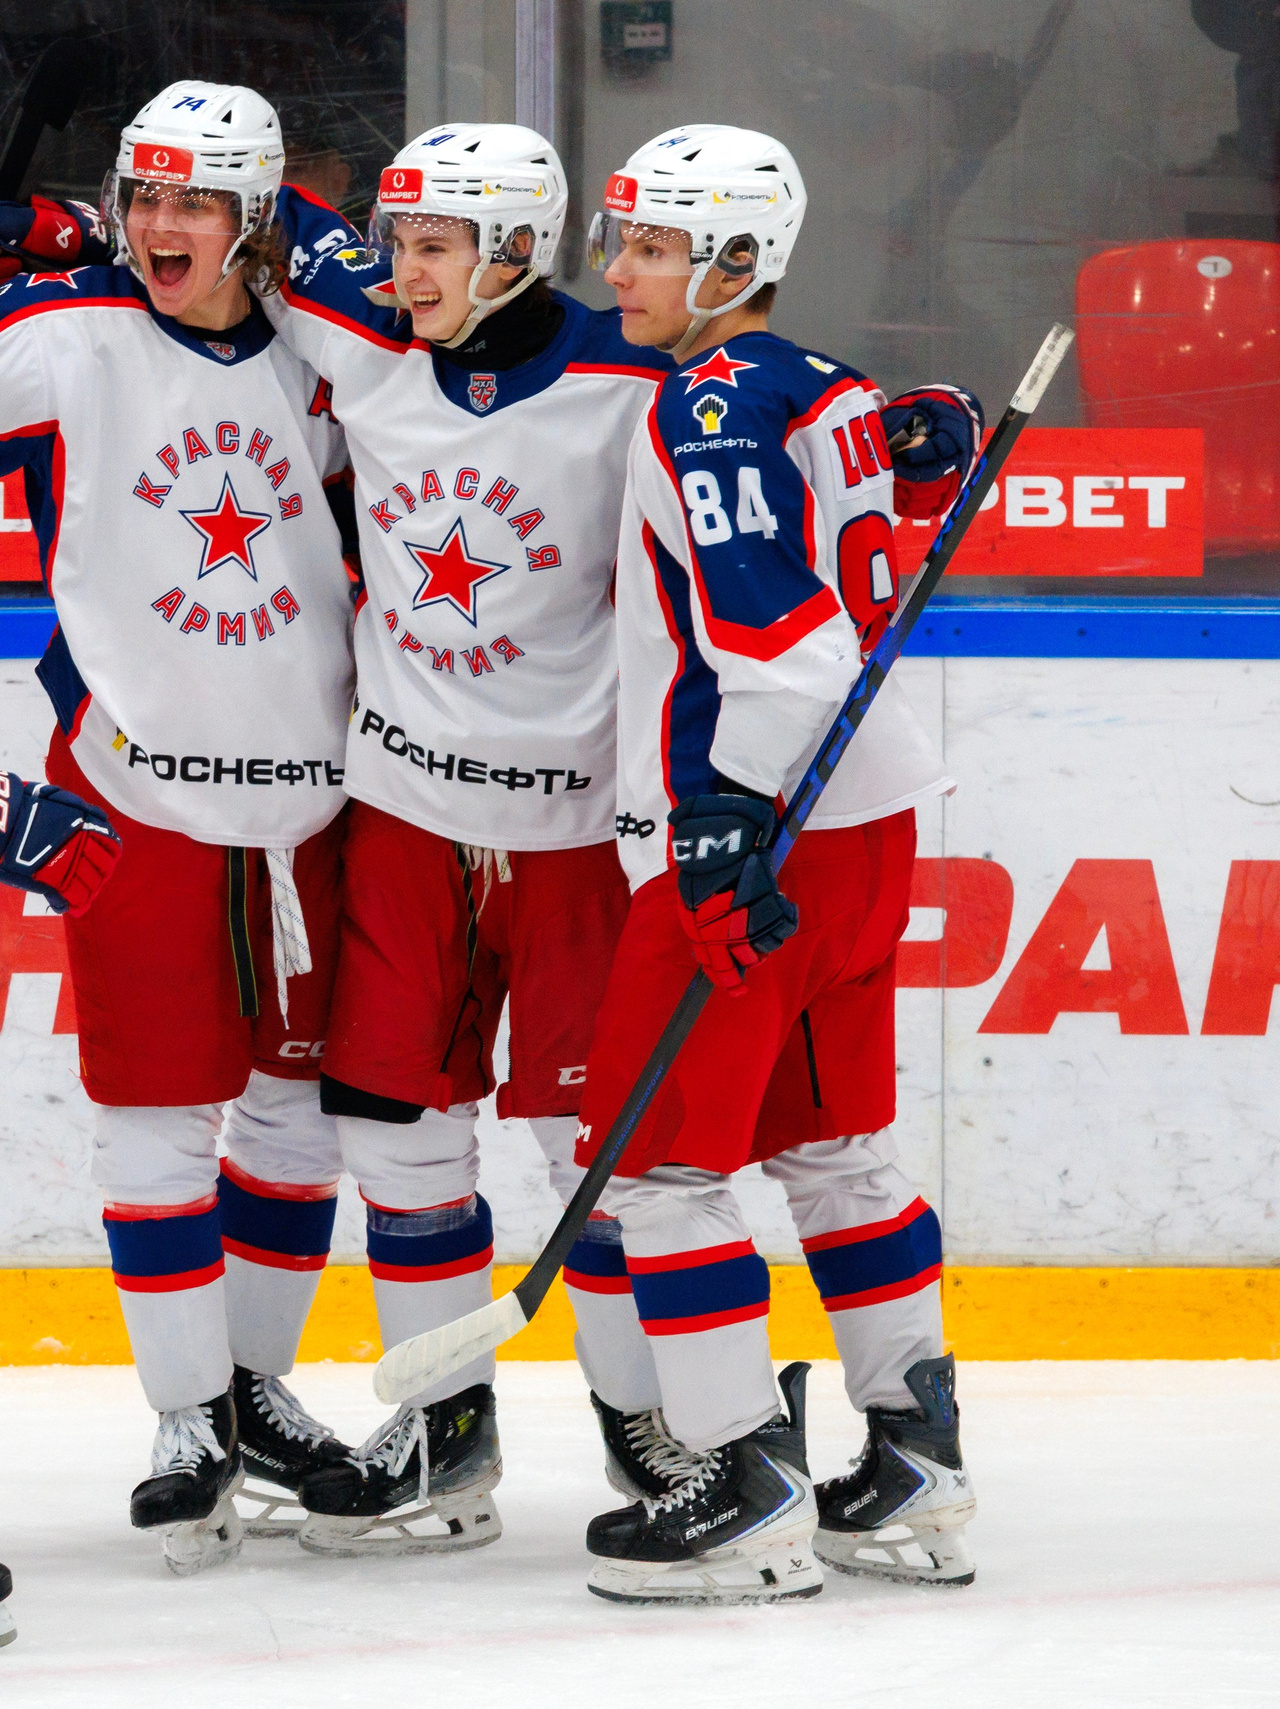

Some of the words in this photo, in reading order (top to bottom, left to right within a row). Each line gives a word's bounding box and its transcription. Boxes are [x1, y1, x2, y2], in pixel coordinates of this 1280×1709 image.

[172, 96, 208, 112] 74
[135, 167, 188, 180] OLIMPBET
[381, 191, 420, 200] OLIMPBET
[605, 196, 633, 209] OLIMPBET
[673, 437, 758, 457] РОСНЕФТЬ
[133, 421, 303, 520] КРАСНАЯ
[368, 466, 562, 572] КРАСНАЯ
[681, 466, 779, 547] 84
[152, 584, 301, 646] АРМИЯ
[384, 608, 525, 678] АРМИЯ
[360, 708, 592, 796] РОСНЕФТЬ
[844, 1489, 879, 1517] BAUER
